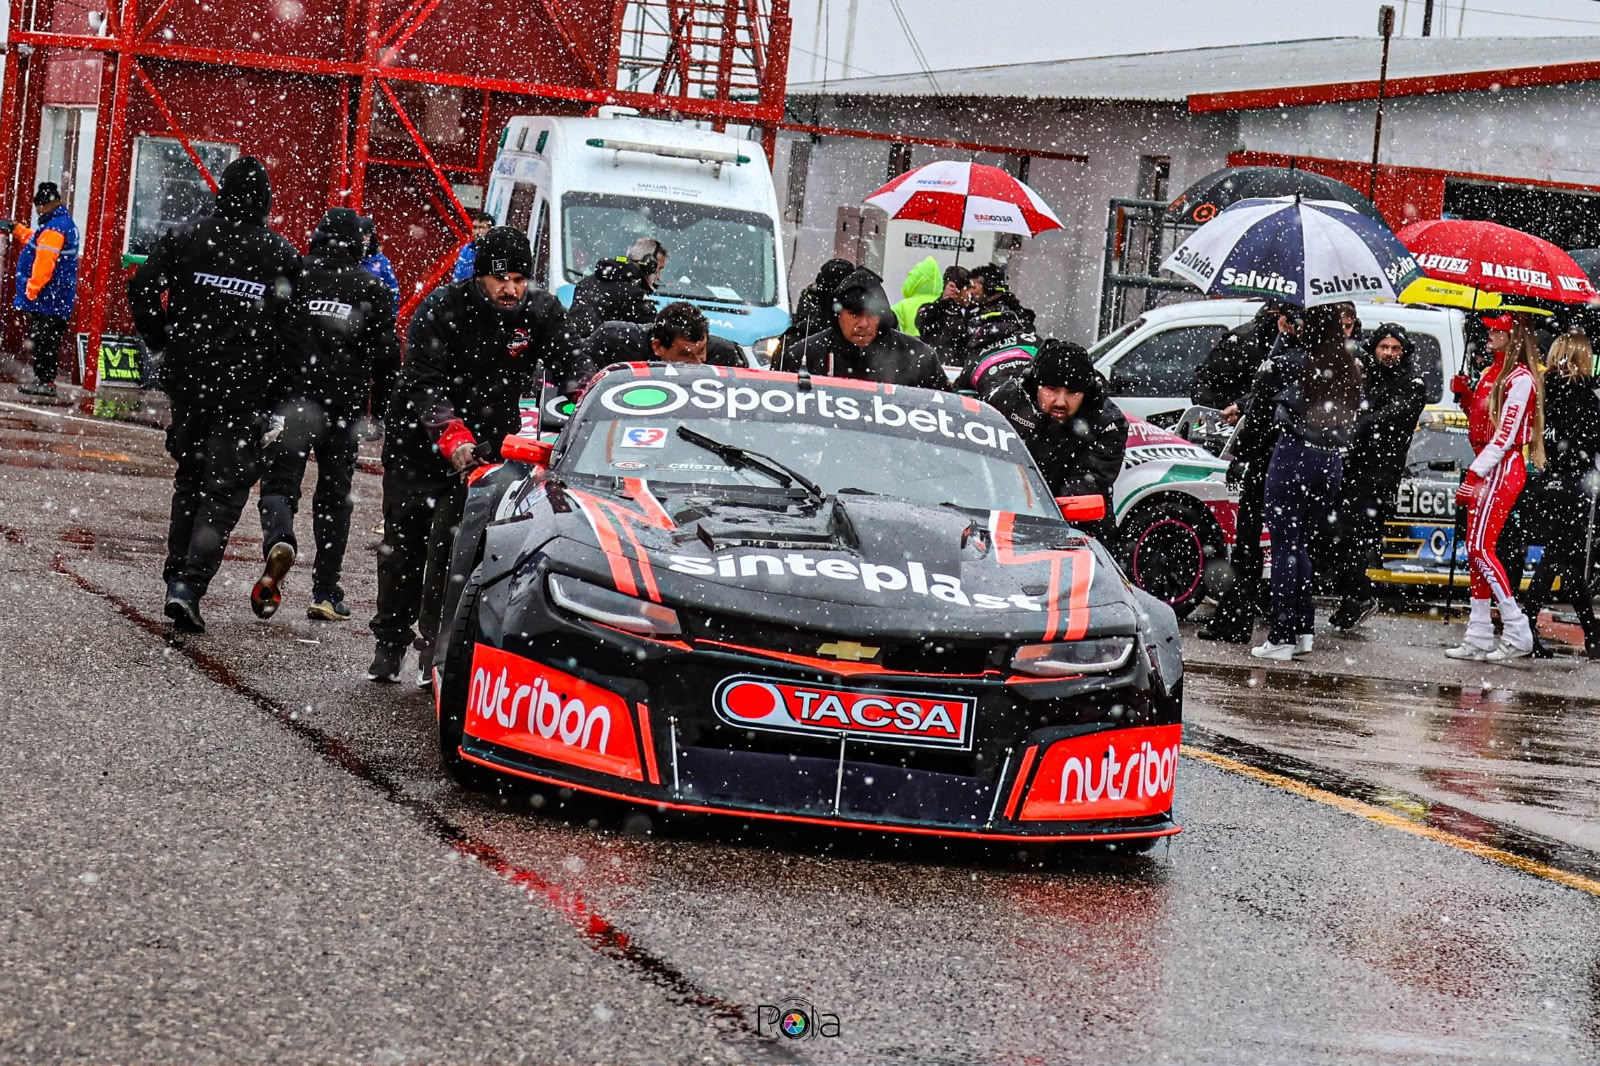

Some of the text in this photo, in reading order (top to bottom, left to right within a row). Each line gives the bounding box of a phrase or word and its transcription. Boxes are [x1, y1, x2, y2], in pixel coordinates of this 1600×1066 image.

[1174, 246, 1215, 279] Salvita
[1481, 261, 1552, 288] NAHUEL
[193, 271, 267, 296] TROTTA
[1221, 267, 1298, 294] Salvita
[1310, 273, 1383, 296] Salvita
[690, 378, 1016, 451] Sports.bet.ar
[1011, 413, 1035, 429] Kappa
[668, 553, 1042, 611] sinteplast
[470, 666, 611, 755] nutribon
[794, 691, 956, 734] TACSA
[1059, 741, 1178, 804] nutribon
